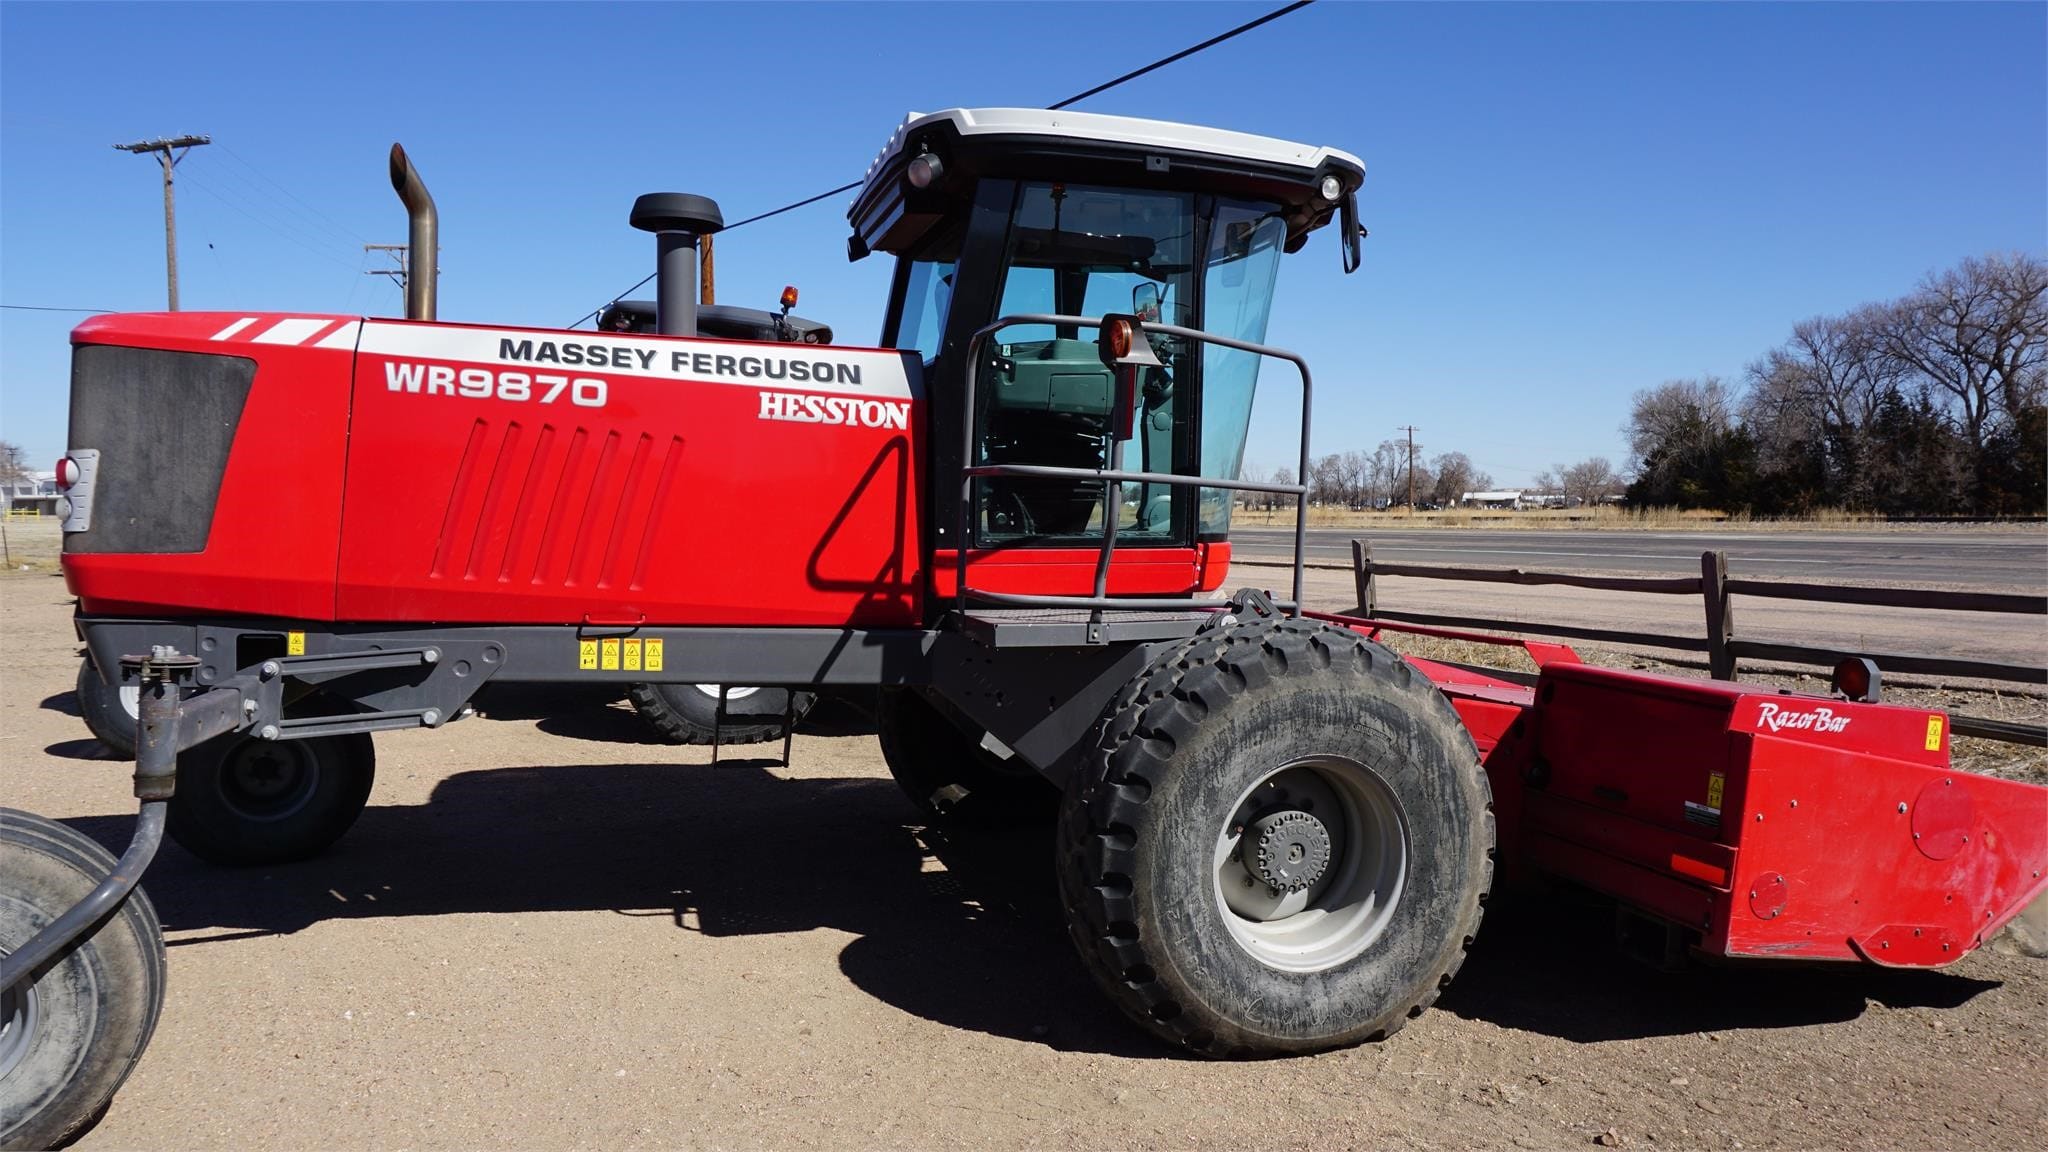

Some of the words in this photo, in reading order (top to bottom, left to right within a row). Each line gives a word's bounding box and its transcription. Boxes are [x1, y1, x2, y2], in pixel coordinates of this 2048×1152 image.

[500, 338, 657, 370] MASSEY
[671, 351, 862, 385] FERGUSON
[384, 362, 608, 408] WR9870
[758, 391, 911, 430] HESSTON
[1757, 702, 1852, 733] RazorBar
